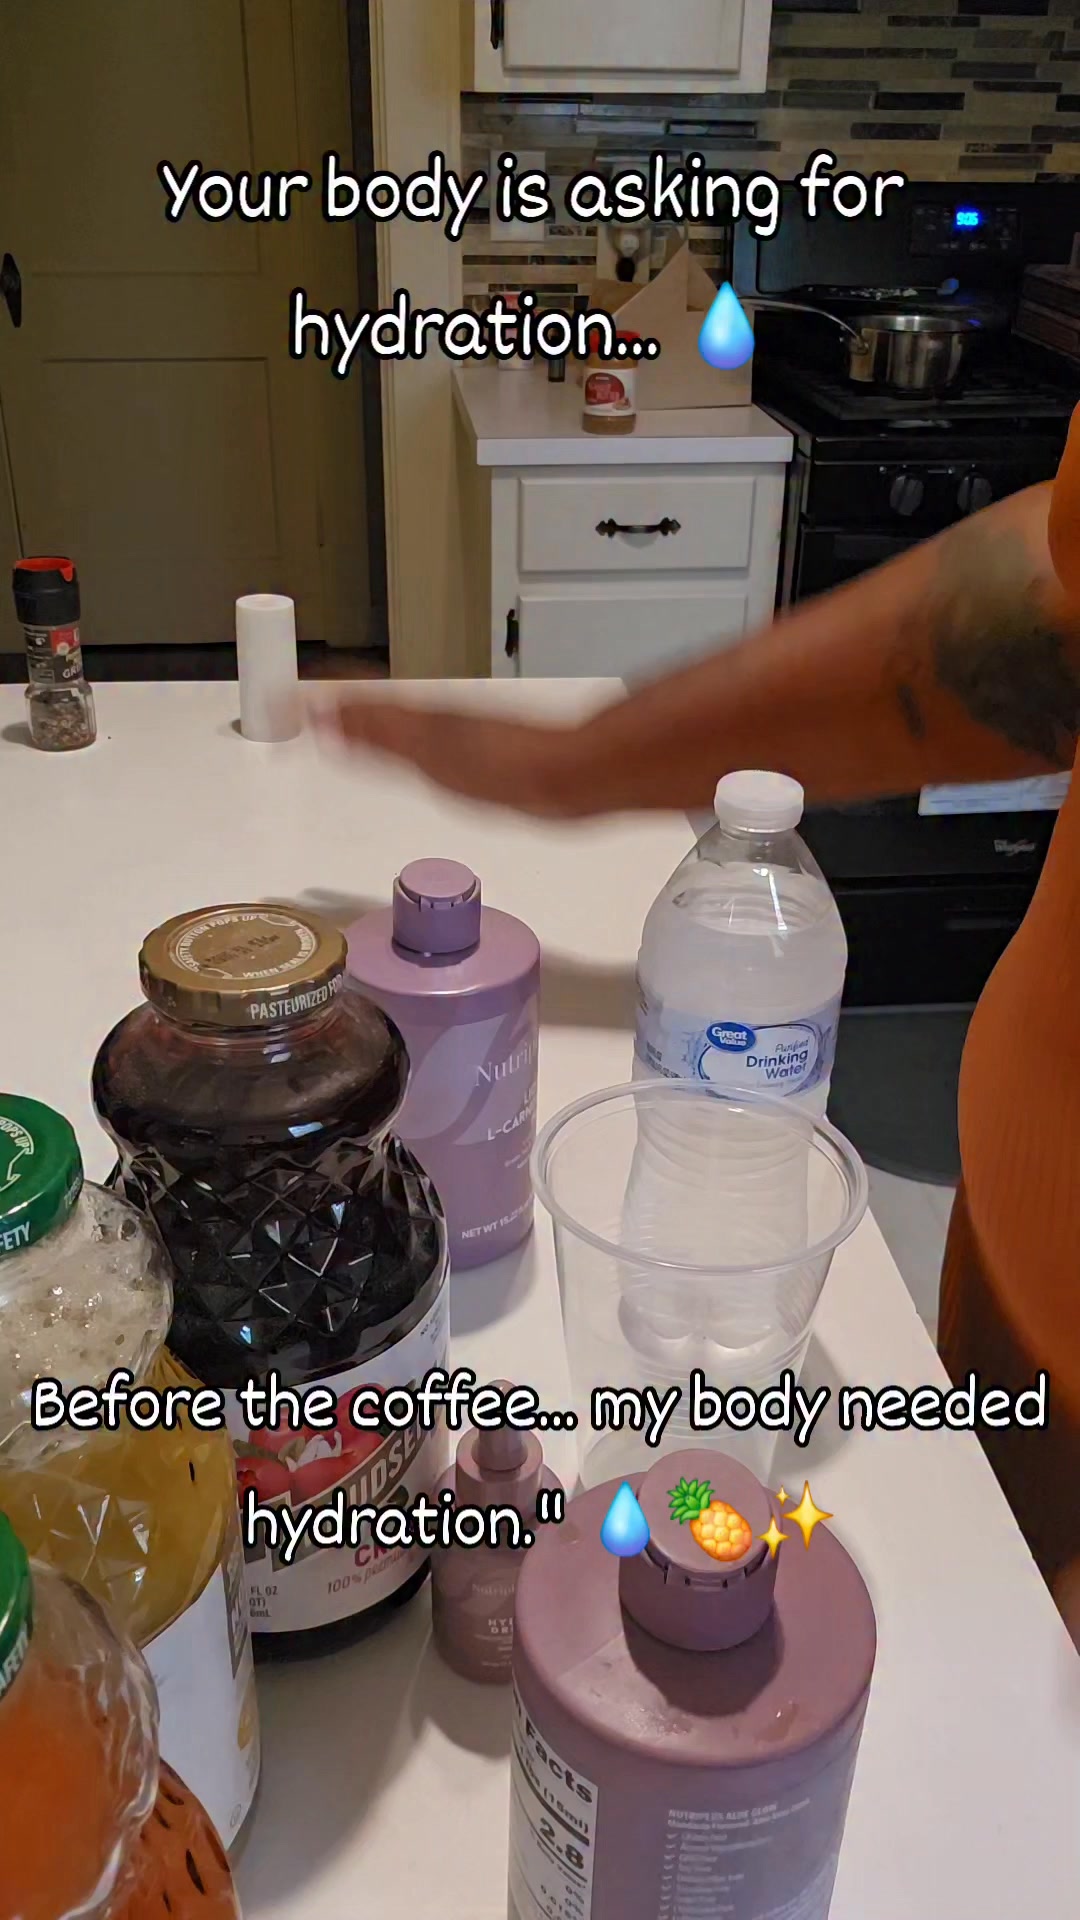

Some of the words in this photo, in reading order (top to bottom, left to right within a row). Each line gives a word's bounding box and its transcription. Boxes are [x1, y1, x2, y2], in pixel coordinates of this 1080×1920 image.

[242, 967, 280, 978] WHEN
[250, 986, 328, 1020] PASTEURIZED
[711, 1026, 747, 1040] Great
[720, 1036, 747, 1046] Value
[745, 1049, 809, 1068] Drinking
[765, 1062, 807, 1080] Water
[14, 1130, 30, 1149] UP
[461, 1226, 482, 1240] NET
[525, 1715, 593, 1804] Facts
[539, 1816, 585, 1870] 2.8
